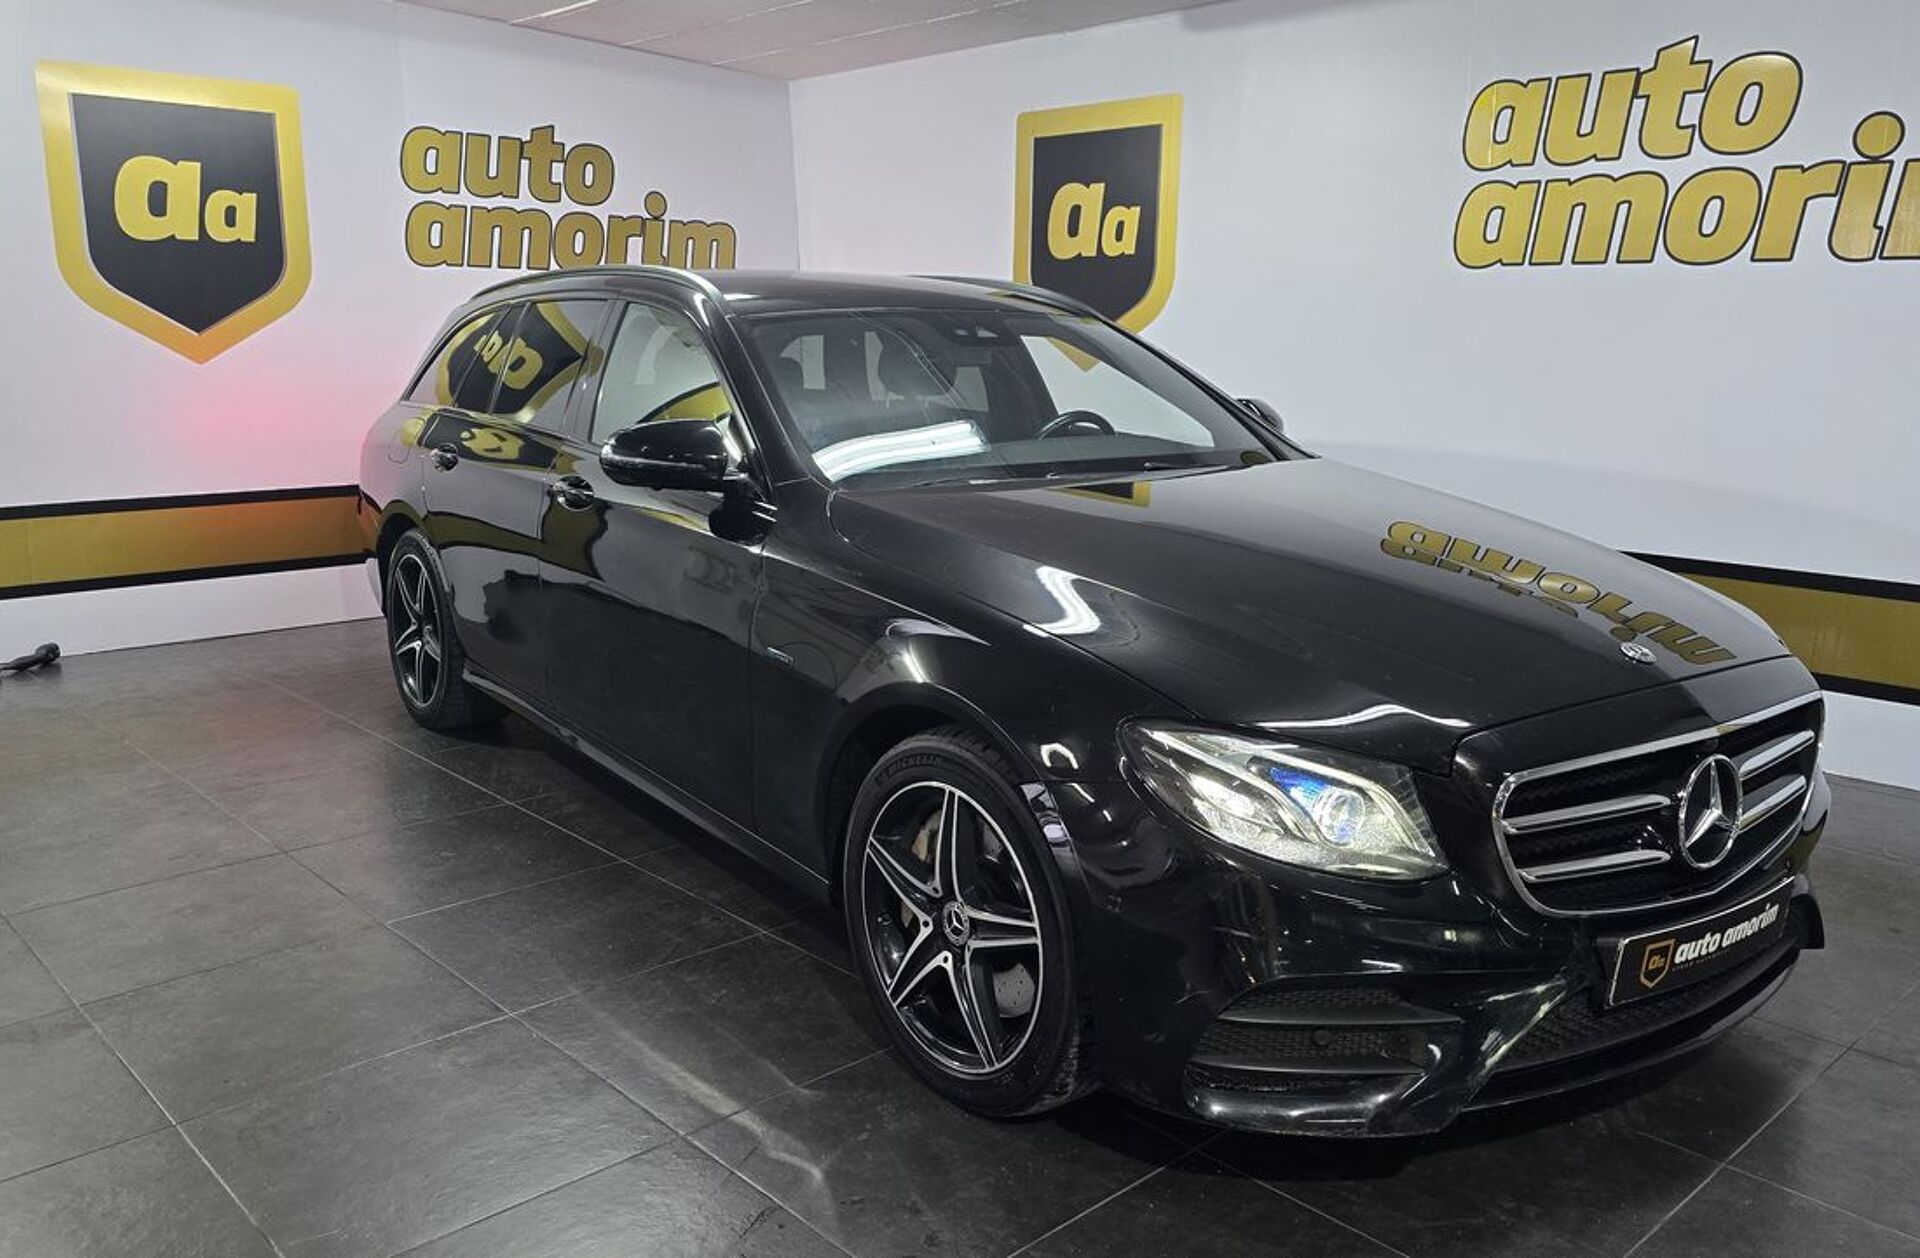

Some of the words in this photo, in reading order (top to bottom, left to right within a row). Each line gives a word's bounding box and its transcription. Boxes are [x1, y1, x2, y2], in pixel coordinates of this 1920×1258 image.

[1462, 35, 1803, 171] auto
[114, 155, 258, 244] aa
[400, 124, 615, 206] auto
[405, 192, 737, 271] amorim
[1047, 182, 1141, 260] aa
[1674, 931, 1721, 964] auto
[1721, 903, 1779, 948] amorim
